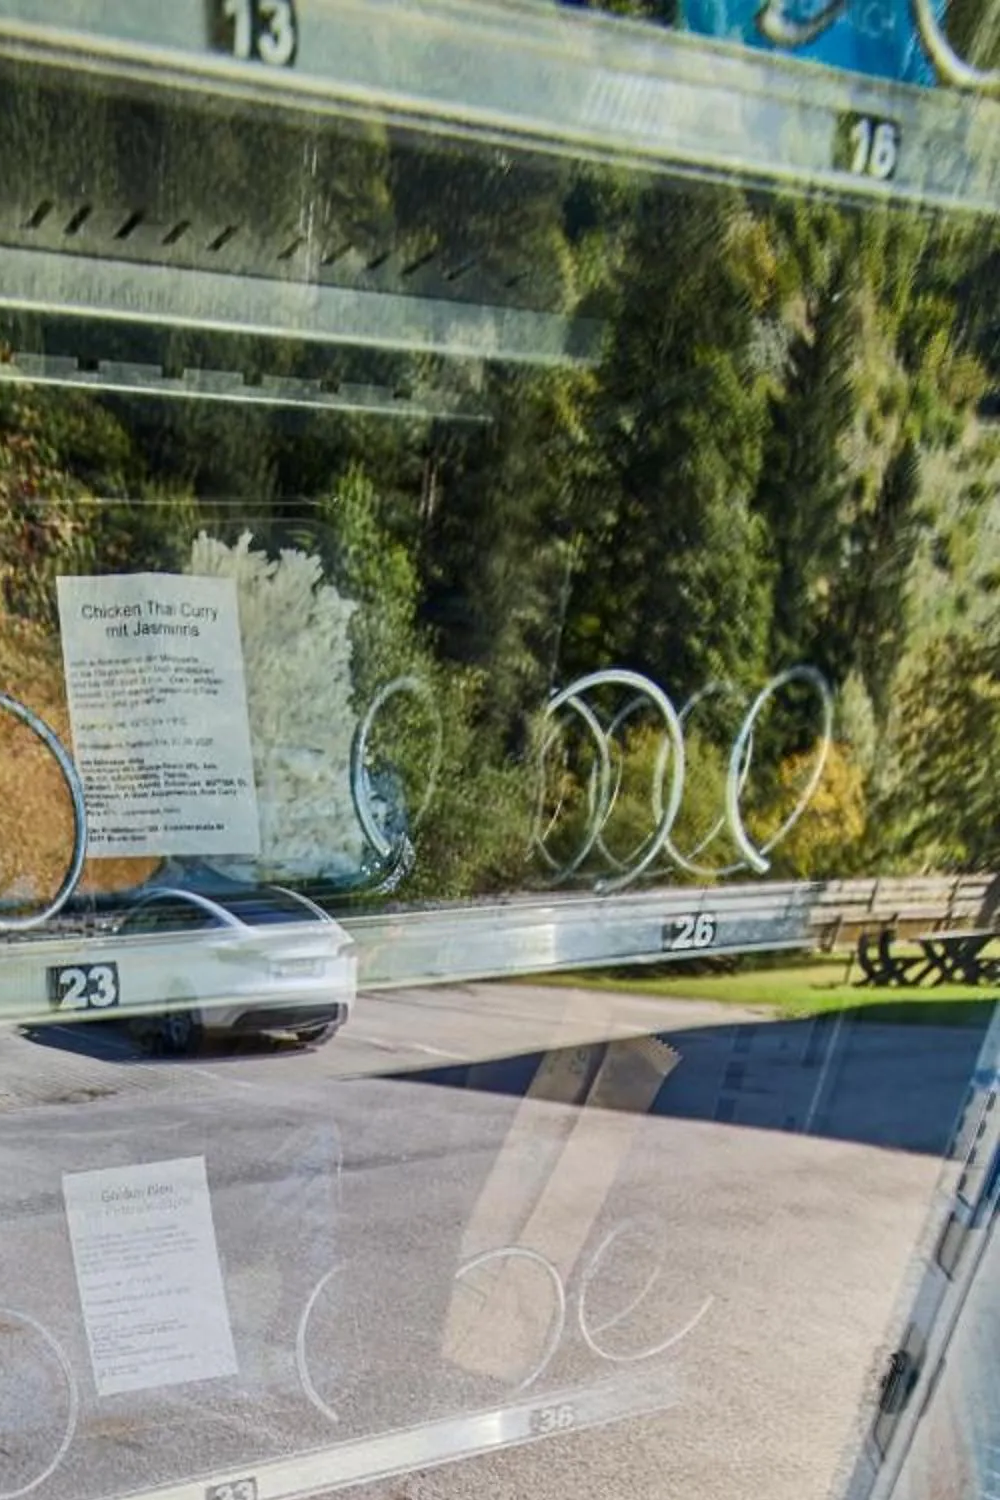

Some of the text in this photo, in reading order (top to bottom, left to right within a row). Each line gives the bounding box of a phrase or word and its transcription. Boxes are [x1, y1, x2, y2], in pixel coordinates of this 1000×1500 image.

[223, 0, 294, 65] 13
[850, 117, 897, 178] 16
[81, 600, 218, 621] Chicken Thai Curry
[105, 623, 129, 638] mit
[671, 913, 714, 949] 26
[60, 966, 117, 1009] 23
